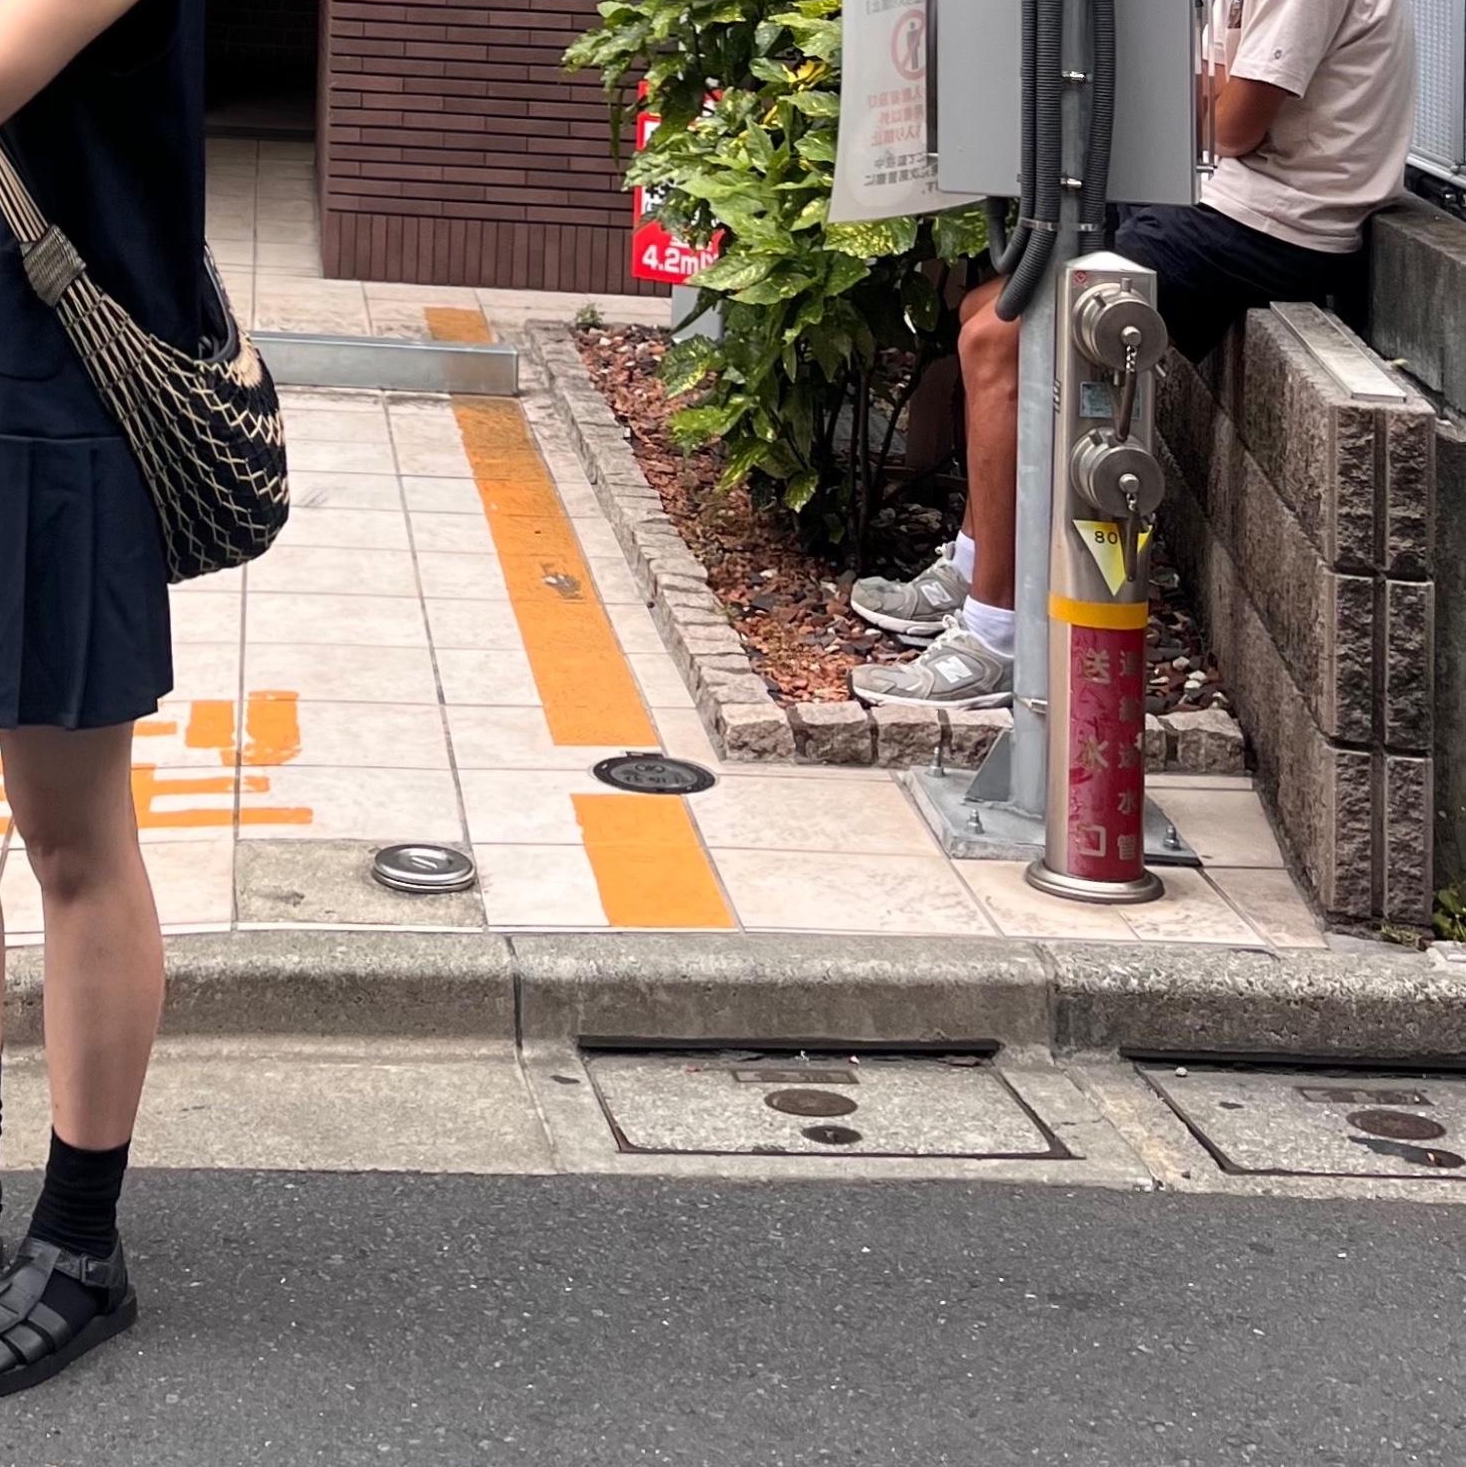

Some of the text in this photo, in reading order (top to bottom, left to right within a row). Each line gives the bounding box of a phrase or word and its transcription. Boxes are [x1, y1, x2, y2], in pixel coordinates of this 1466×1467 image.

[1094, 530, 1119, 546] 80
[921, 581, 952, 606] N
[934, 655, 973, 684] N
[1075, 646, 1112, 859] 送水口
